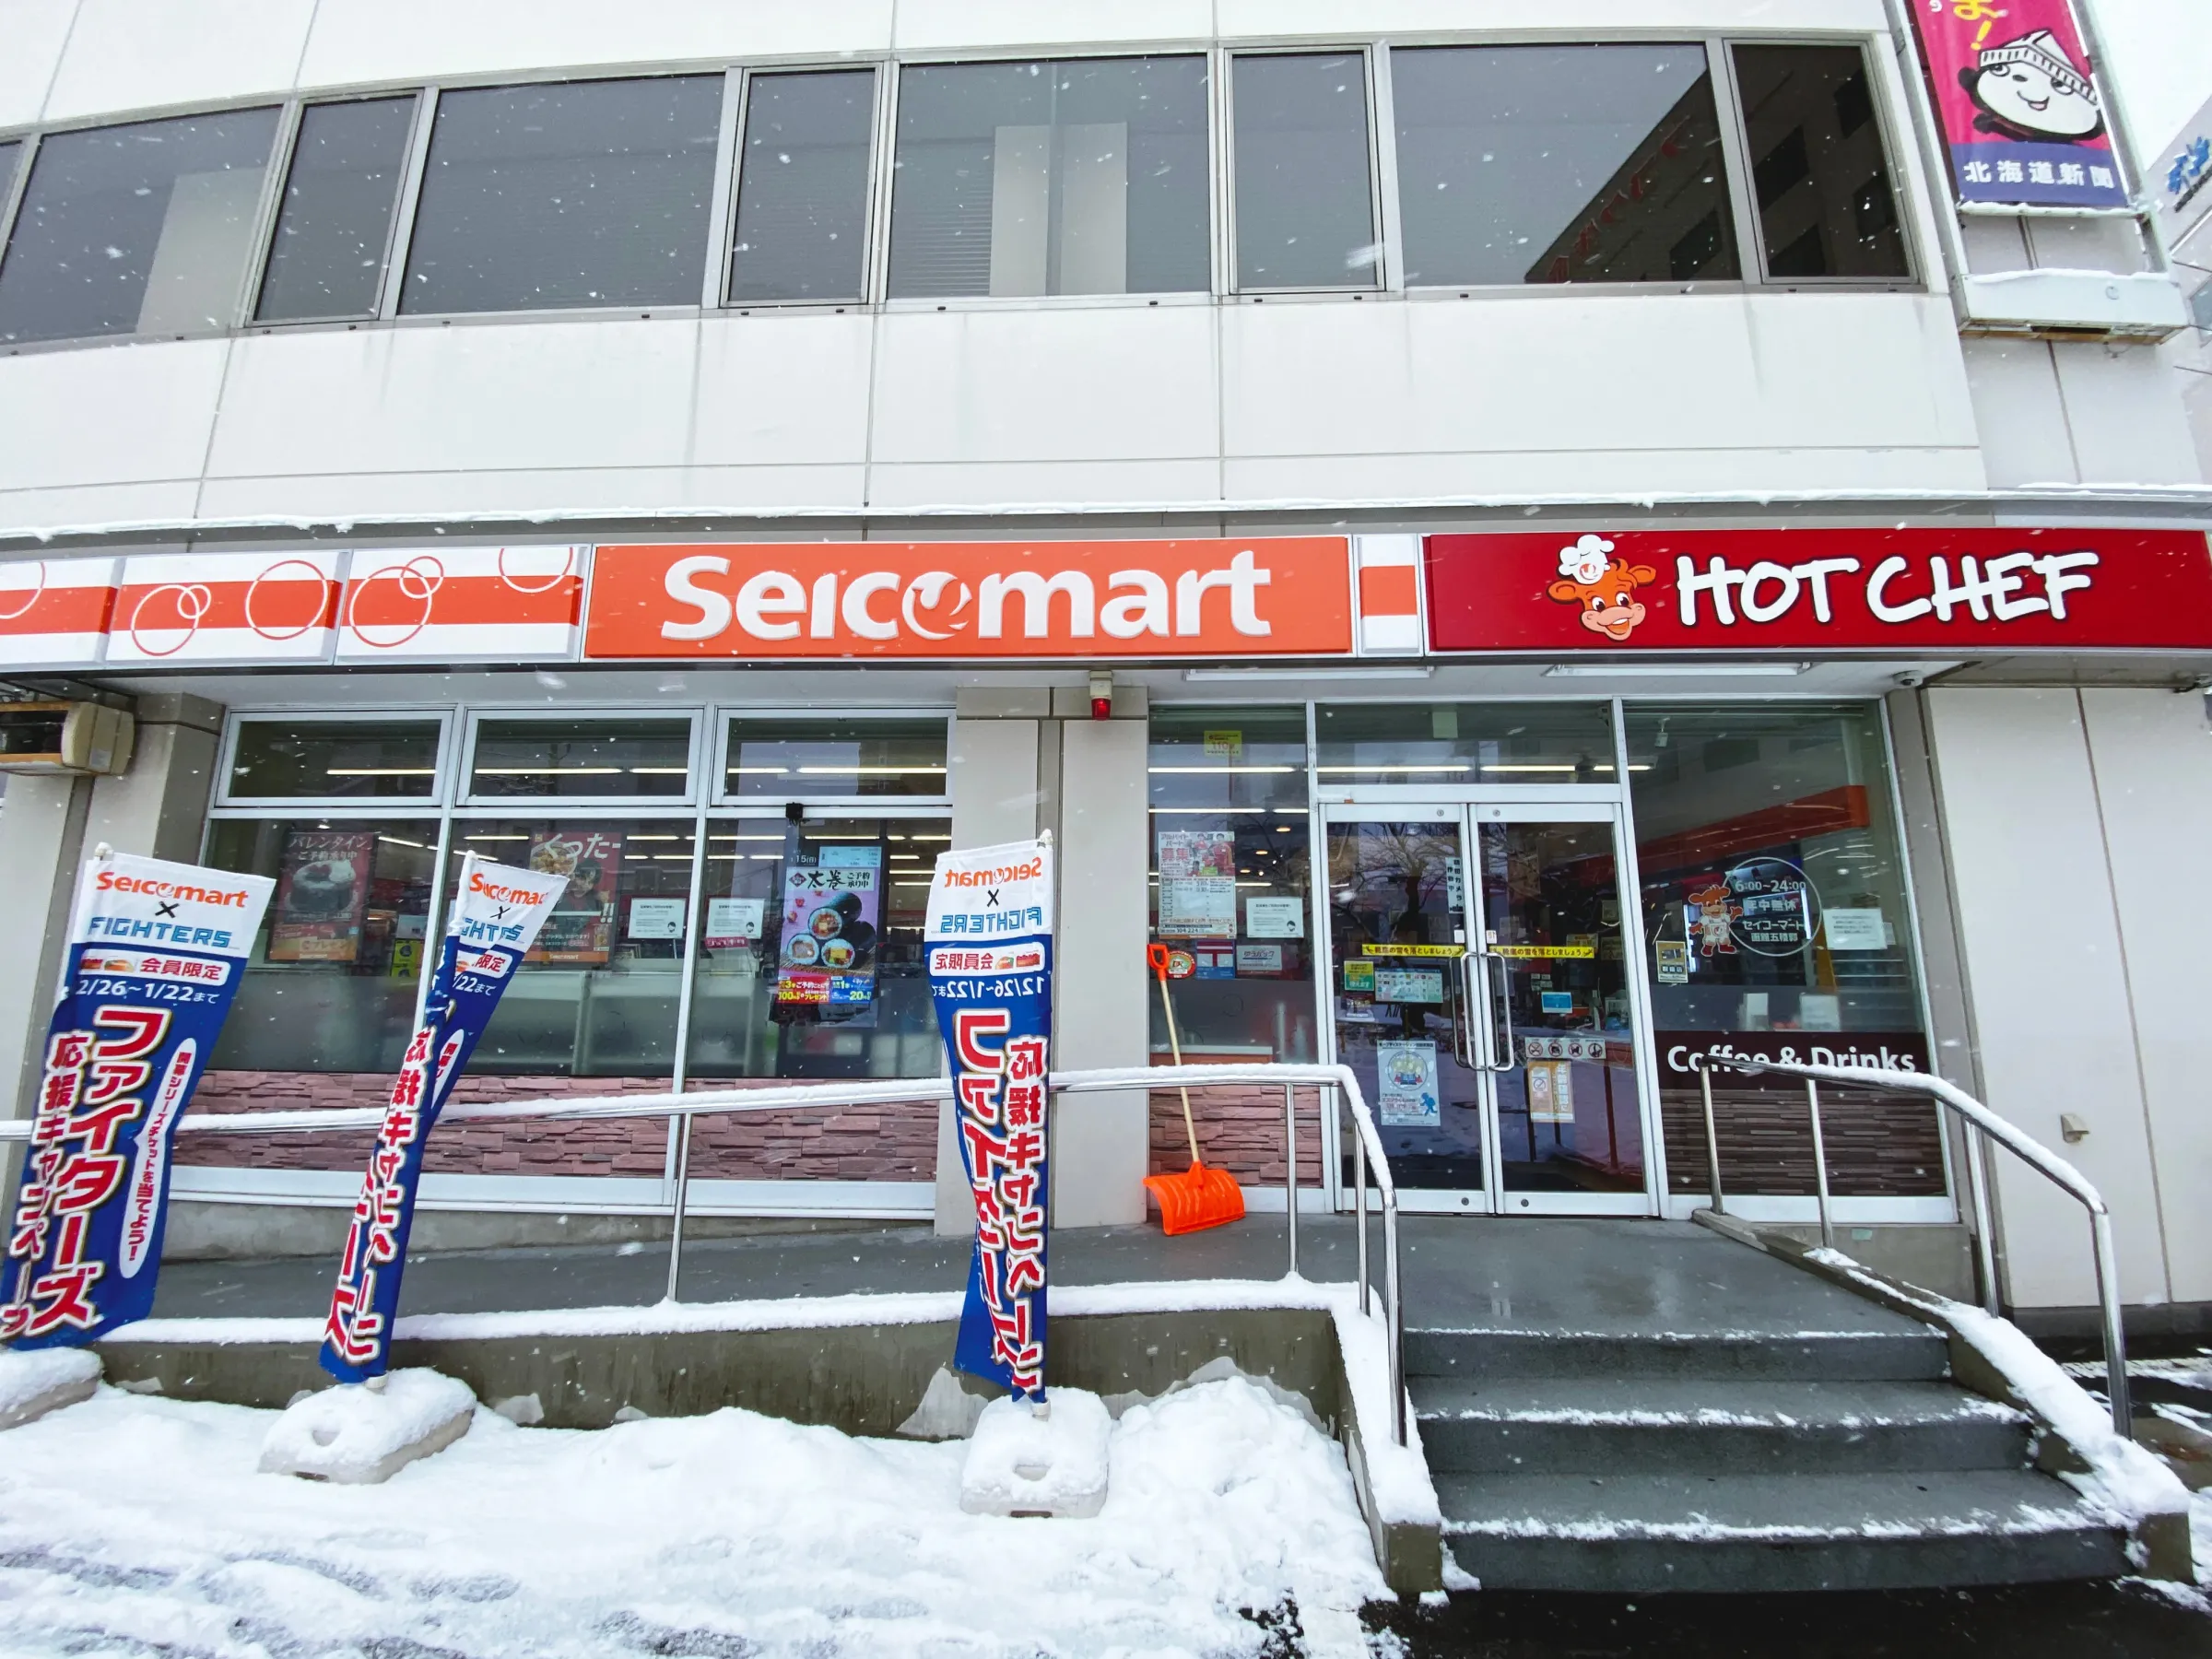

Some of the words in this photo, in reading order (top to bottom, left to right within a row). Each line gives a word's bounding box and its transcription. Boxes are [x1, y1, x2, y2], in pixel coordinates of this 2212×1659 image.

[1963, 160, 2116, 189] 北海道新聞
[661, 549, 1272, 640] Seicomart
[1677, 553, 1858, 627] HOT
[1865, 551, 2100, 625] CHEF
[288, 835, 368, 849] バレンタイン
[807, 869, 847, 891] 太巻
[847, 871, 871, 879] ご予約
[847, 880, 869, 888] 承り中
[96, 872, 249, 908] Seicomart
[1747, 899, 1797, 912] 年中無休
[88, 916, 232, 948] FIGHTERS
[1742, 918, 1805, 931] セイコーマート
[1750, 932, 1798, 942] 函館五稜郭
[1374, 946, 1453, 956] 靴底の雪を落としましょう
[1502, 947, 1582, 957] 靴底の雪を落としましょう
[140, 958, 223, 981] 会員限定
[1810, 1045, 1916, 1073] Drinks
[25, 1004, 172, 1336] ファイターズ
[0, 1030, 96, 1337] 応援キャンペーン
